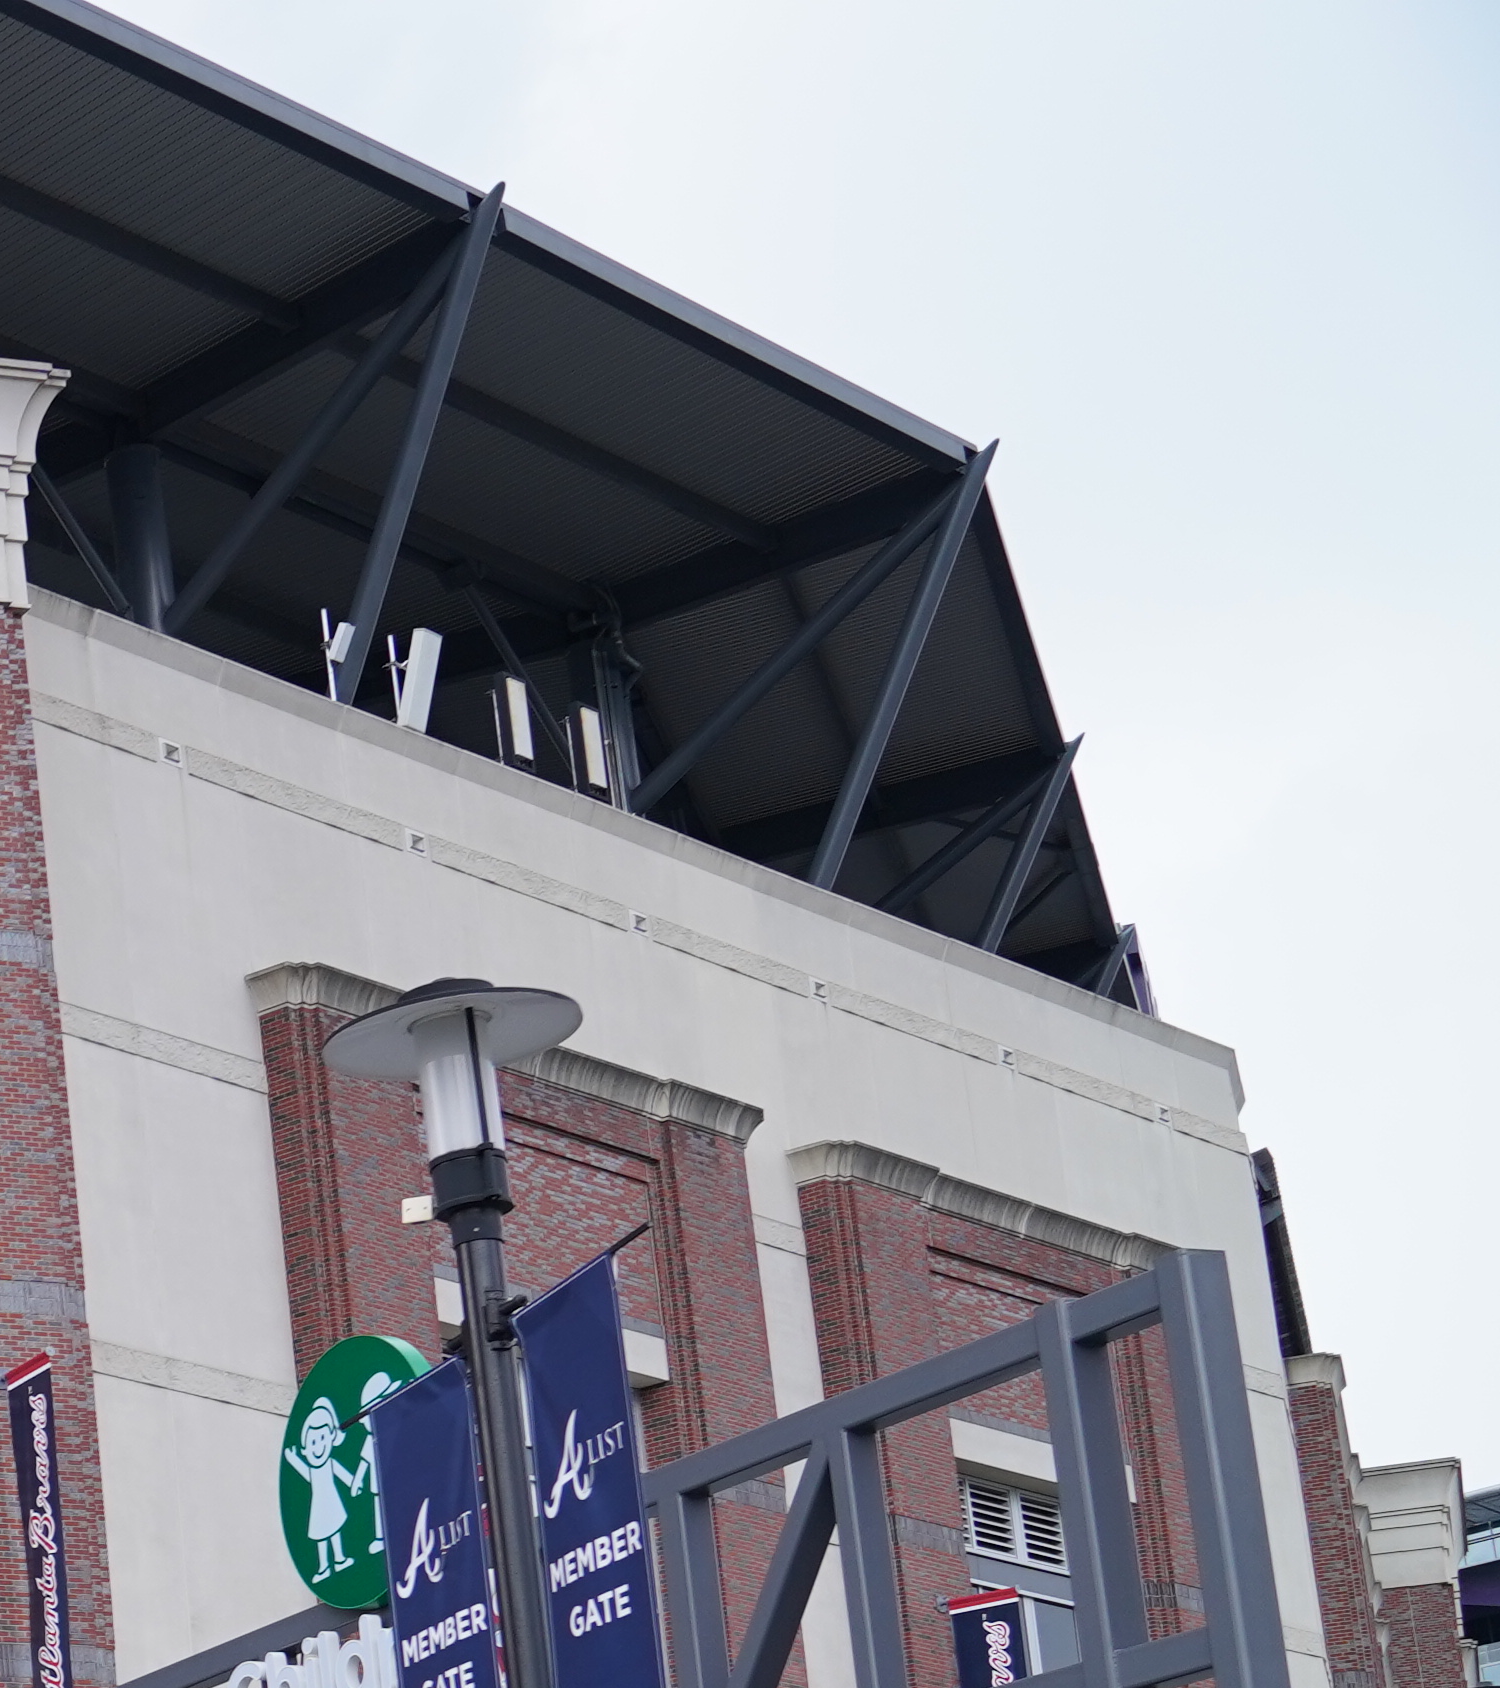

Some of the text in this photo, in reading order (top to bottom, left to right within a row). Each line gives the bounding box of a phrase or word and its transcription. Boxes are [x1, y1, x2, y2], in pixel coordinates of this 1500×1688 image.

[586, 1421, 625, 1465] LIST
[28, 1393, 57, 1553] Braves
[440, 1510, 473, 1556] LIST
[549, 1521, 642, 1594] MEMBER
[401, 1603, 487, 1668] MEMBER
[569, 1585, 632, 1637] GATE
